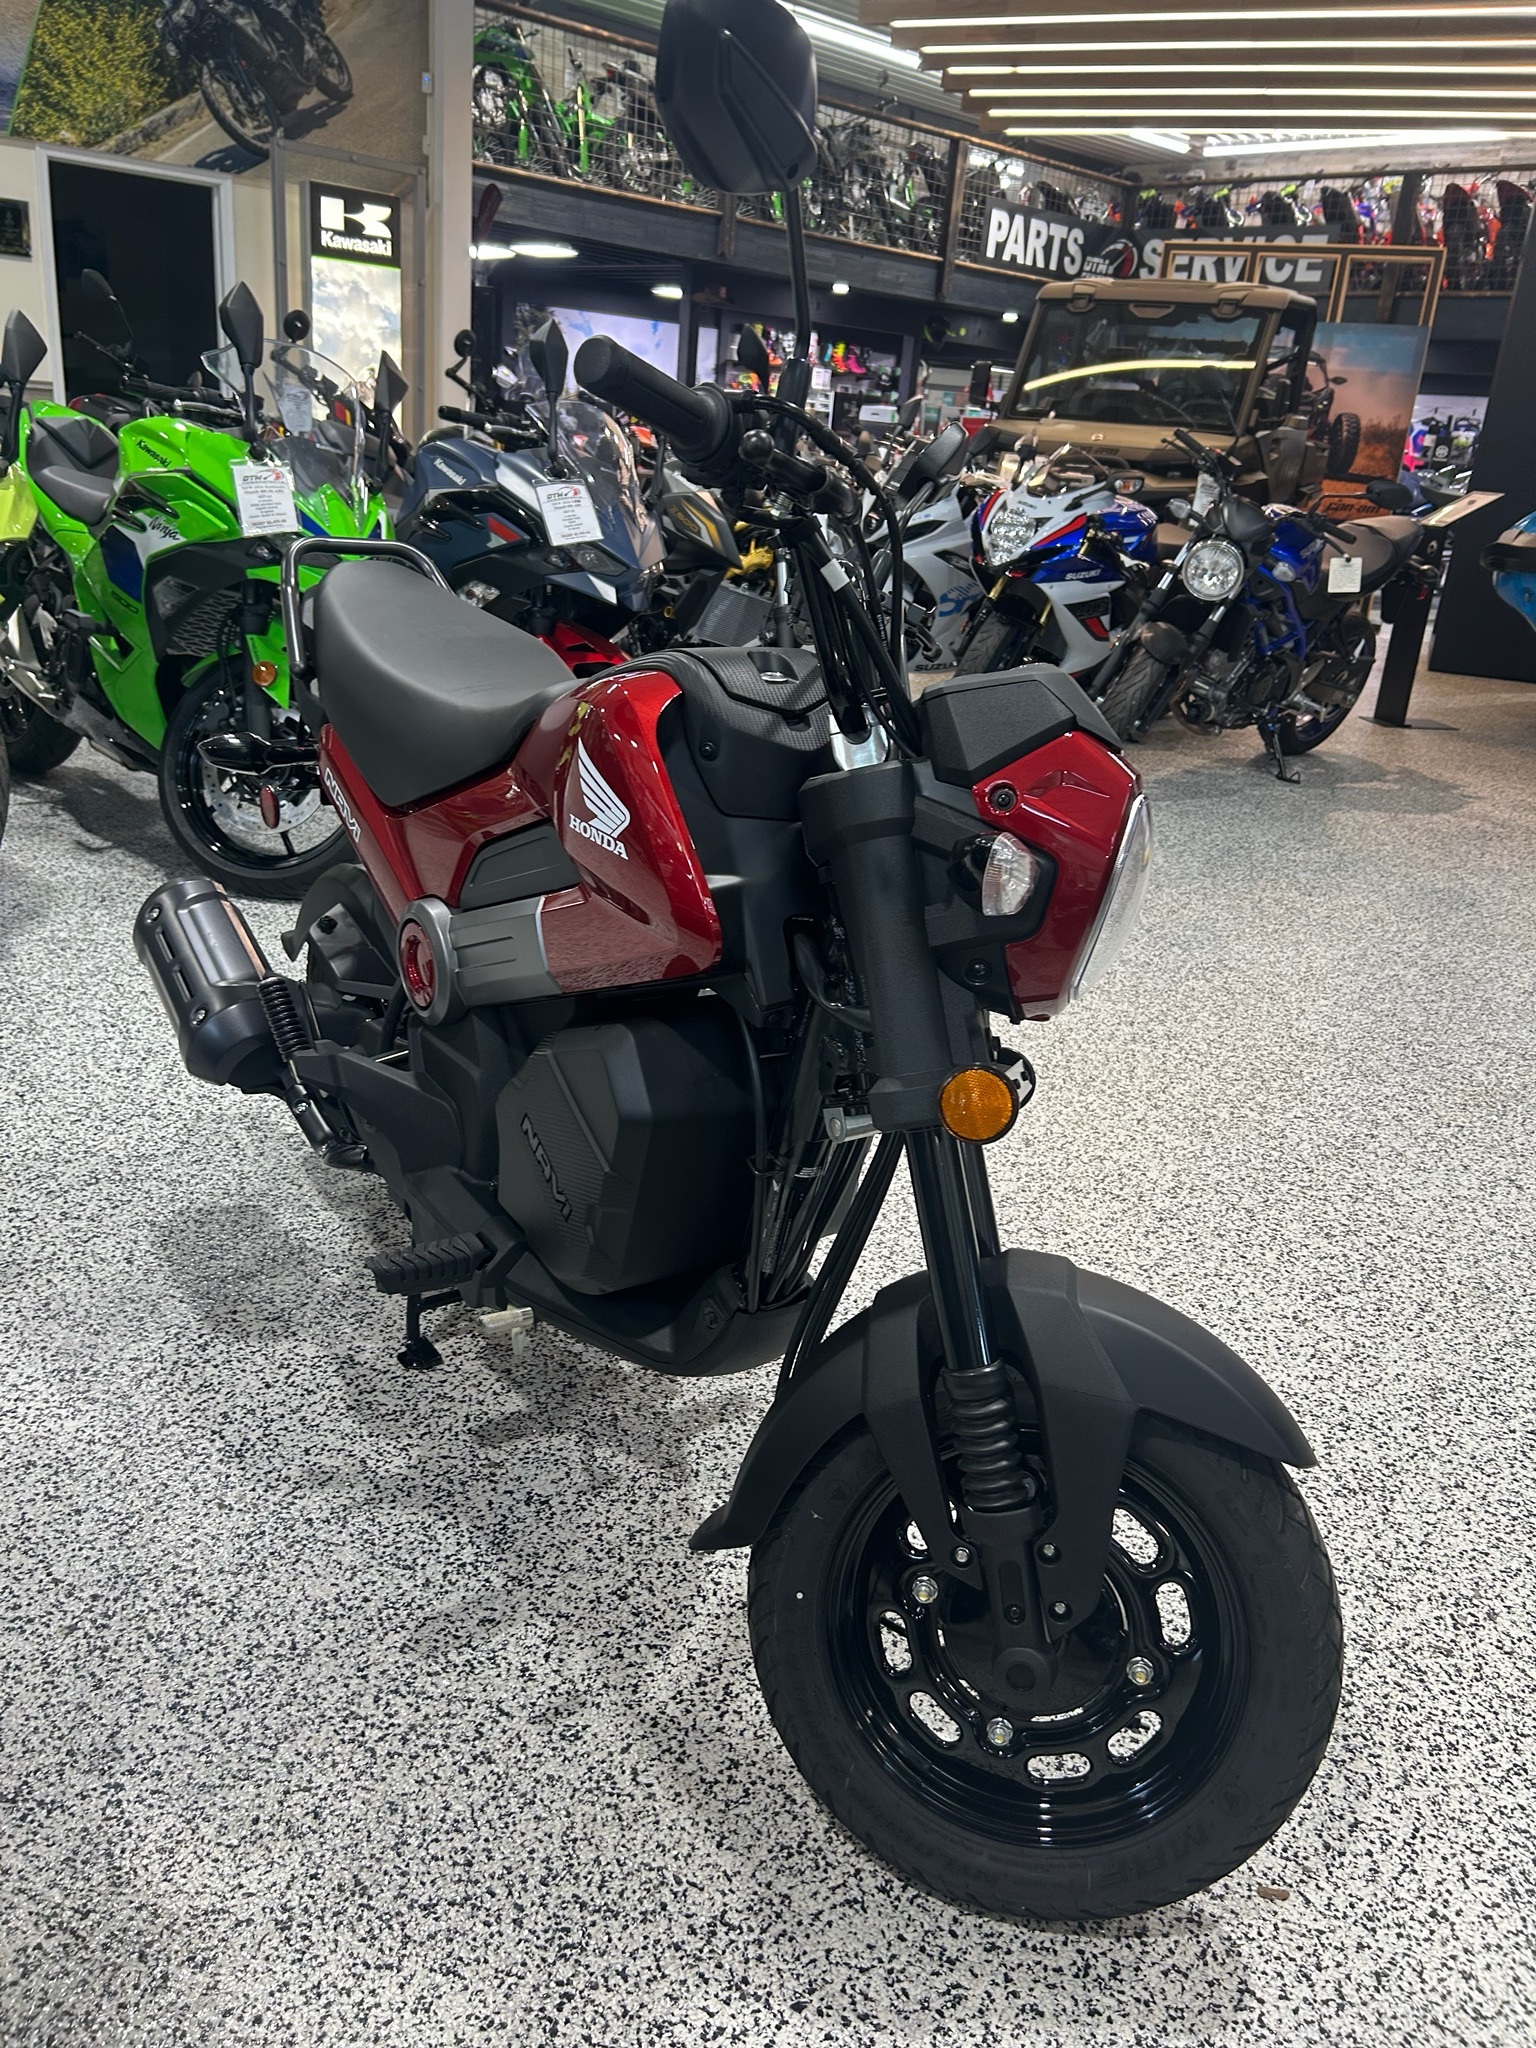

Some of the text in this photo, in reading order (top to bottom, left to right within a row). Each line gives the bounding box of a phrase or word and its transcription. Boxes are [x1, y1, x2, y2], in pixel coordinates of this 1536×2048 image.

[320, 228, 393, 258] Kawasaki
[986, 207, 1085, 276] PARTS
[1140, 234, 1329, 283] SERVCE
[136, 439, 173, 468] Kawasaki
[433, 457, 467, 486] Kawasaki
[149, 516, 180, 542] Ninja
[1065, 568, 1102, 580] SUZUKI
[324, 767, 361, 843] NAVI
[568, 813, 629, 860] HONDA
[520, 1112, 573, 1223] NAVI
